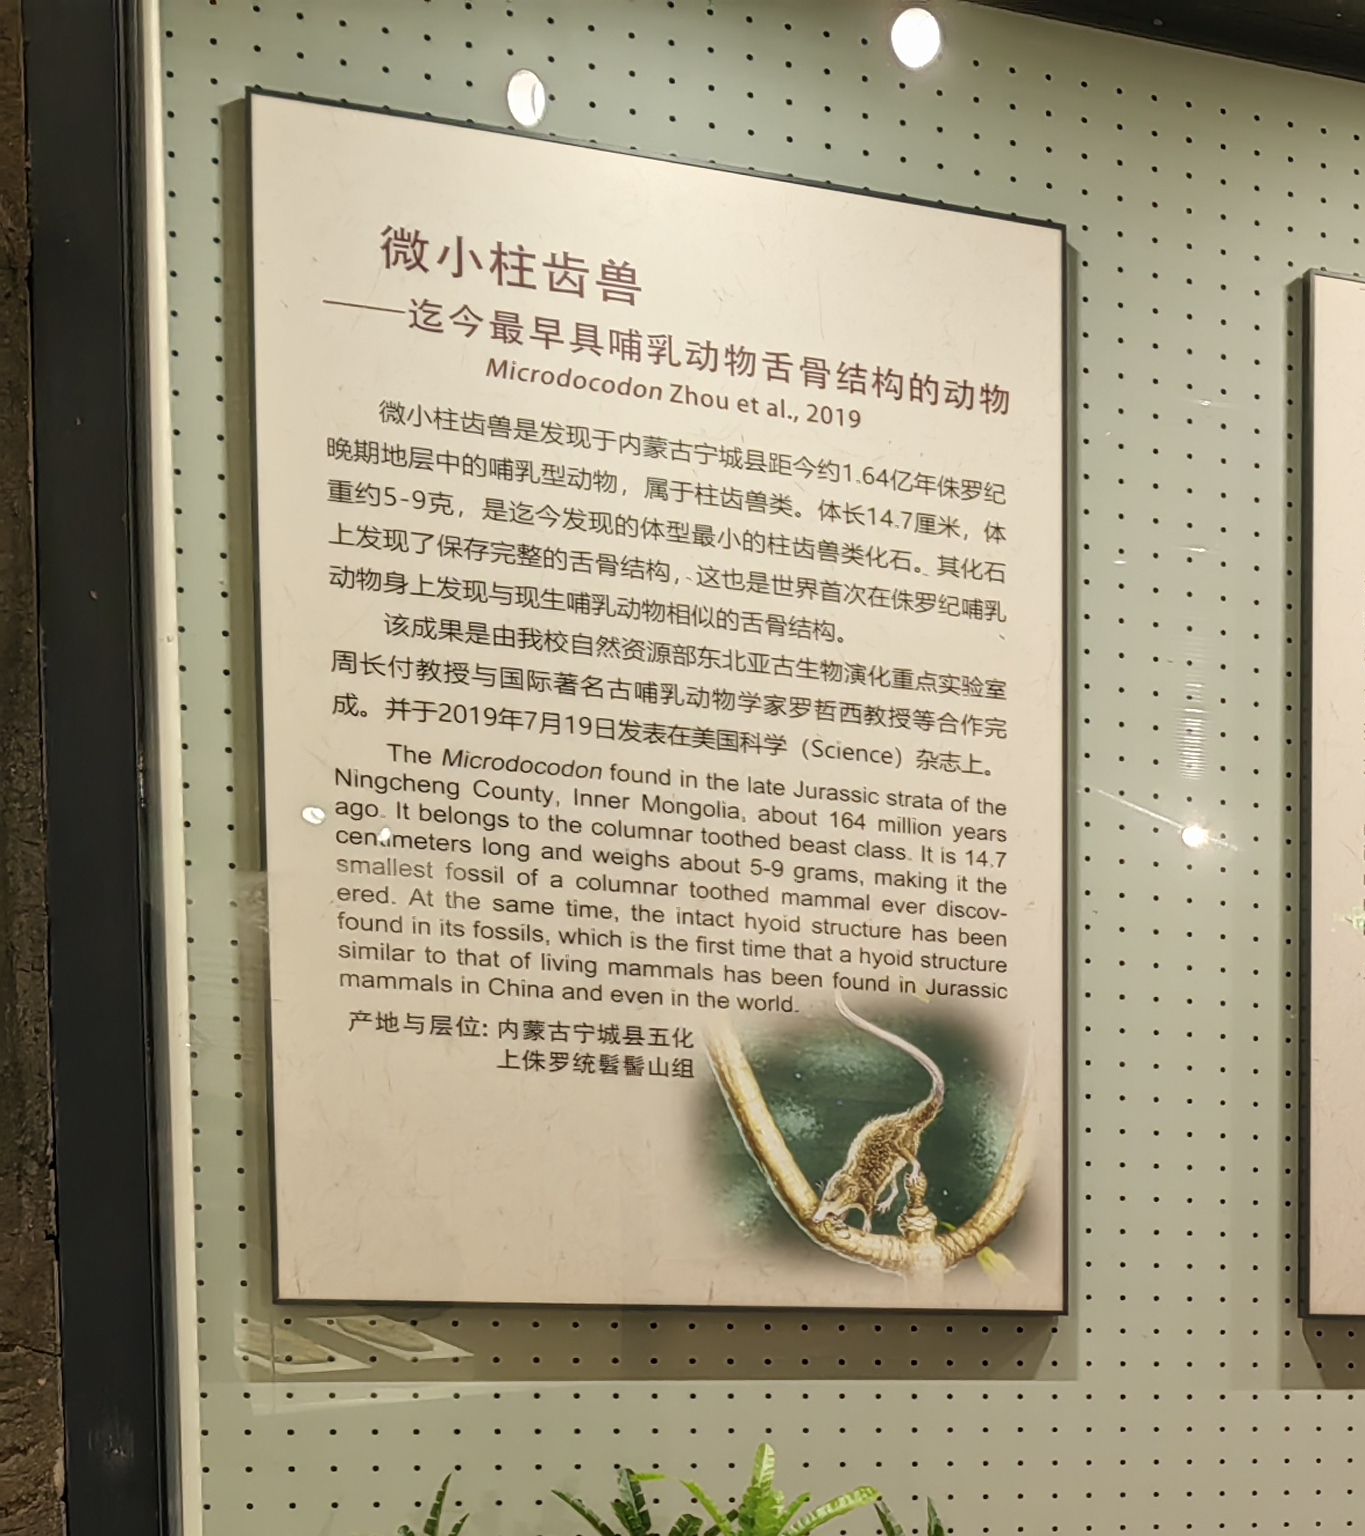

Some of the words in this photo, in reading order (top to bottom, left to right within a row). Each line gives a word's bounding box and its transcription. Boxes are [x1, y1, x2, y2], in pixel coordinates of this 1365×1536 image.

[380, 225, 642, 307] 微小柱齿兽
[485, 357, 663, 401] Microdocodon
[669, 383, 729, 411] Zhou
[737, 397, 760, 415] et
[766, 398, 799, 423] al.,
[806, 403, 862, 429] 2019
[334, 767, 460, 801] Ningcheng
[473, 779, 560, 808] County,
[574, 787, 631, 810] Inner
[641, 793, 746, 823] Mongolia,
[758, 805, 818, 827] about
[829, 810, 866, 831] 164
[878, 816, 942, 837] million
[952, 825, 1008, 843] years
[385, 742, 432, 765] The
[441, 747, 603, 780] Microdocodon
[609, 763, 671, 786] found
[680, 769, 698, 789] in
[705, 772, 740, 793] the
[747, 775, 786, 797] late
[793, 780, 880, 805] Jurassic
[886, 790, 943, 811] strata
[950, 795, 971, 813] of
[976, 797, 1007, 817] the
[339, 973, 453, 994] mammals
[461, 975, 480, 995] in
[488, 977, 554, 999] China
[561, 984, 603, 1002] and
[610, 989, 663, 1006] even
[671, 989, 689, 1007] in
[696, 990, 730, 1009] the
[736, 994, 799, 1013] world.
[498, 1017, 695, 1049] 内蒙古宁城县五化
